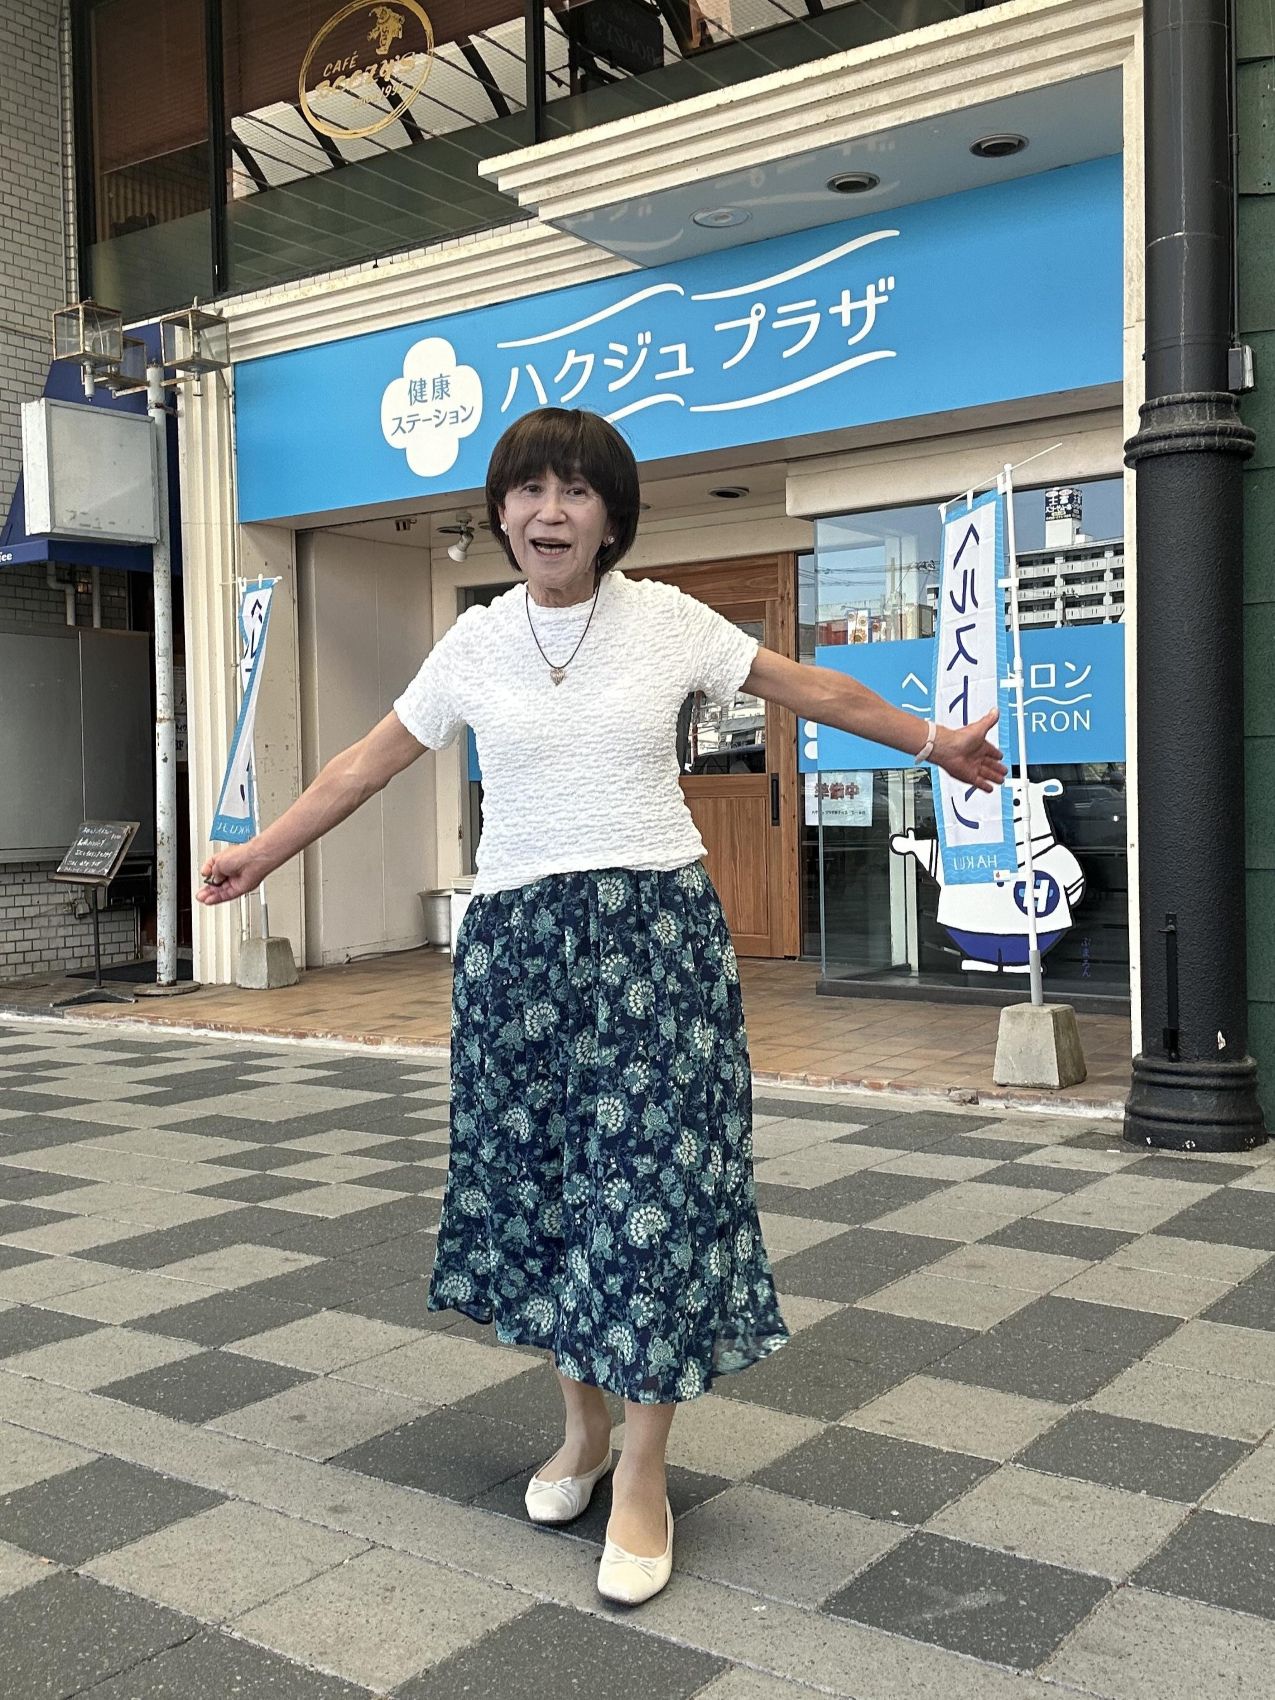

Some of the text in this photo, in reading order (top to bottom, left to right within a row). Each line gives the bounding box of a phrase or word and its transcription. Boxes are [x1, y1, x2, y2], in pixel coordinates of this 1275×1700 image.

[323, 51, 359, 77] CAFÉ
[500, 276, 896, 413] ハクジュ プラザ
[408, 373, 451, 406] 健康
[391, 405, 474, 436] ステーション
